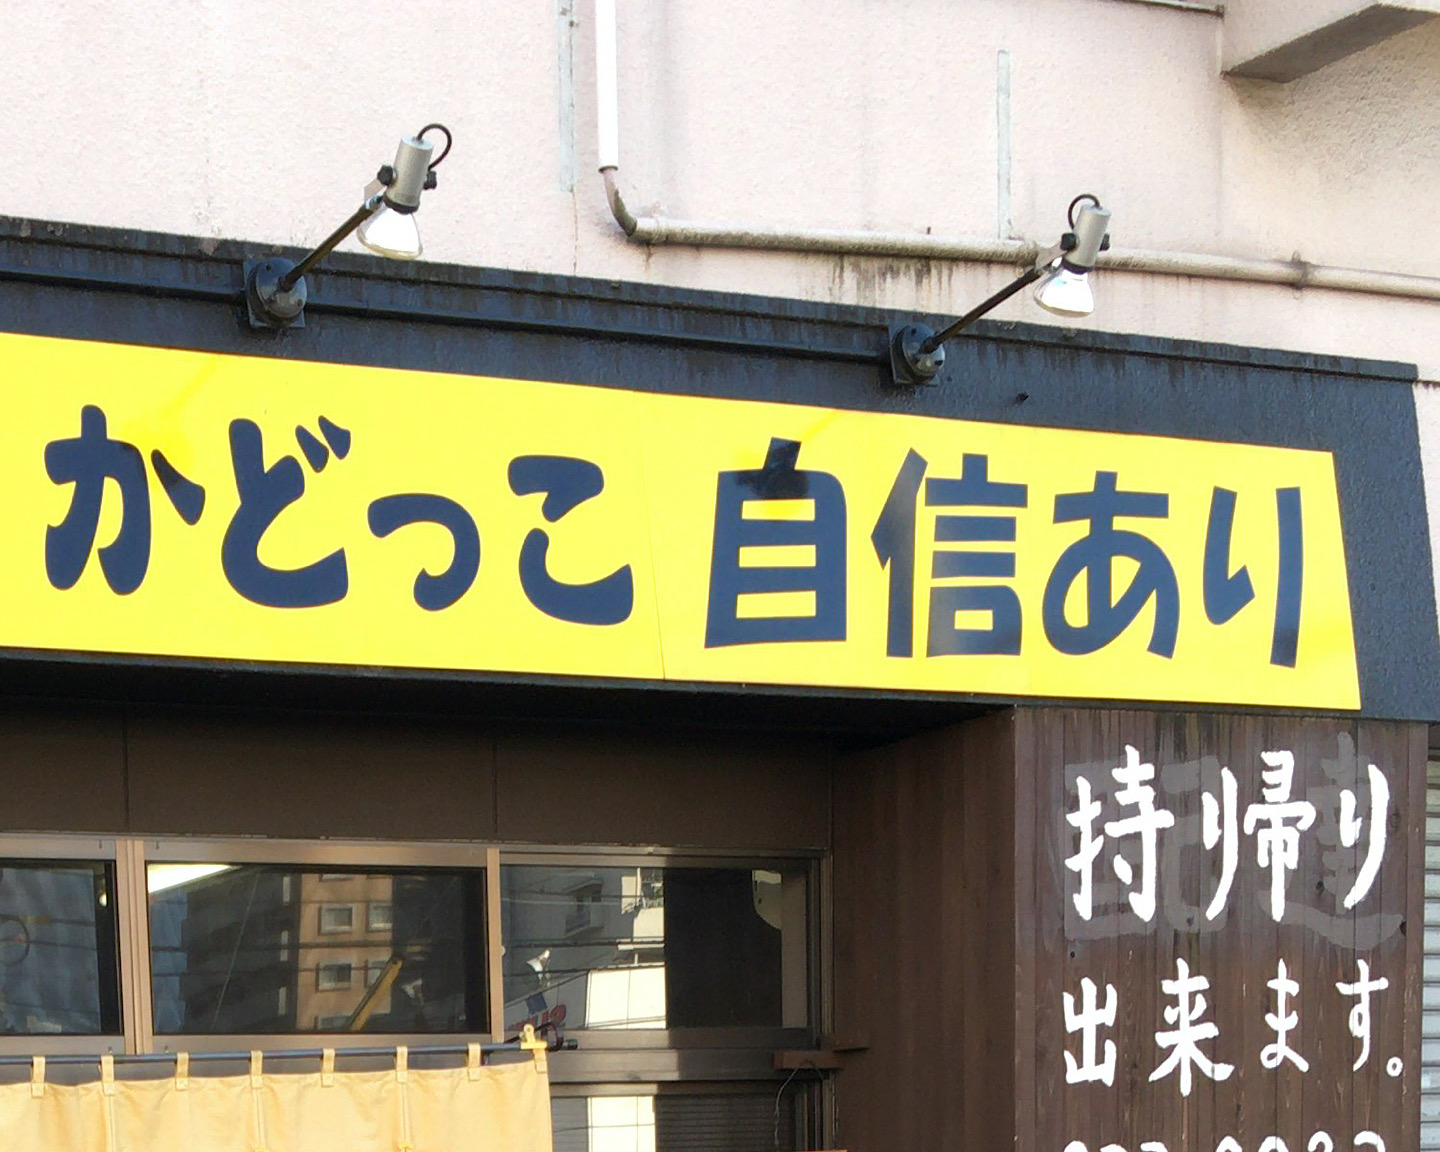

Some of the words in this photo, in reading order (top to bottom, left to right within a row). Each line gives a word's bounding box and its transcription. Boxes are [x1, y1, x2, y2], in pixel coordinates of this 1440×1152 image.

[44, 402, 634, 625] かどっこ
[704, 436, 1302, 669] 自信あり
[1063, 743, 1391, 923] 持帰り
[1062, 956, 1404, 1096] 出来ます。
